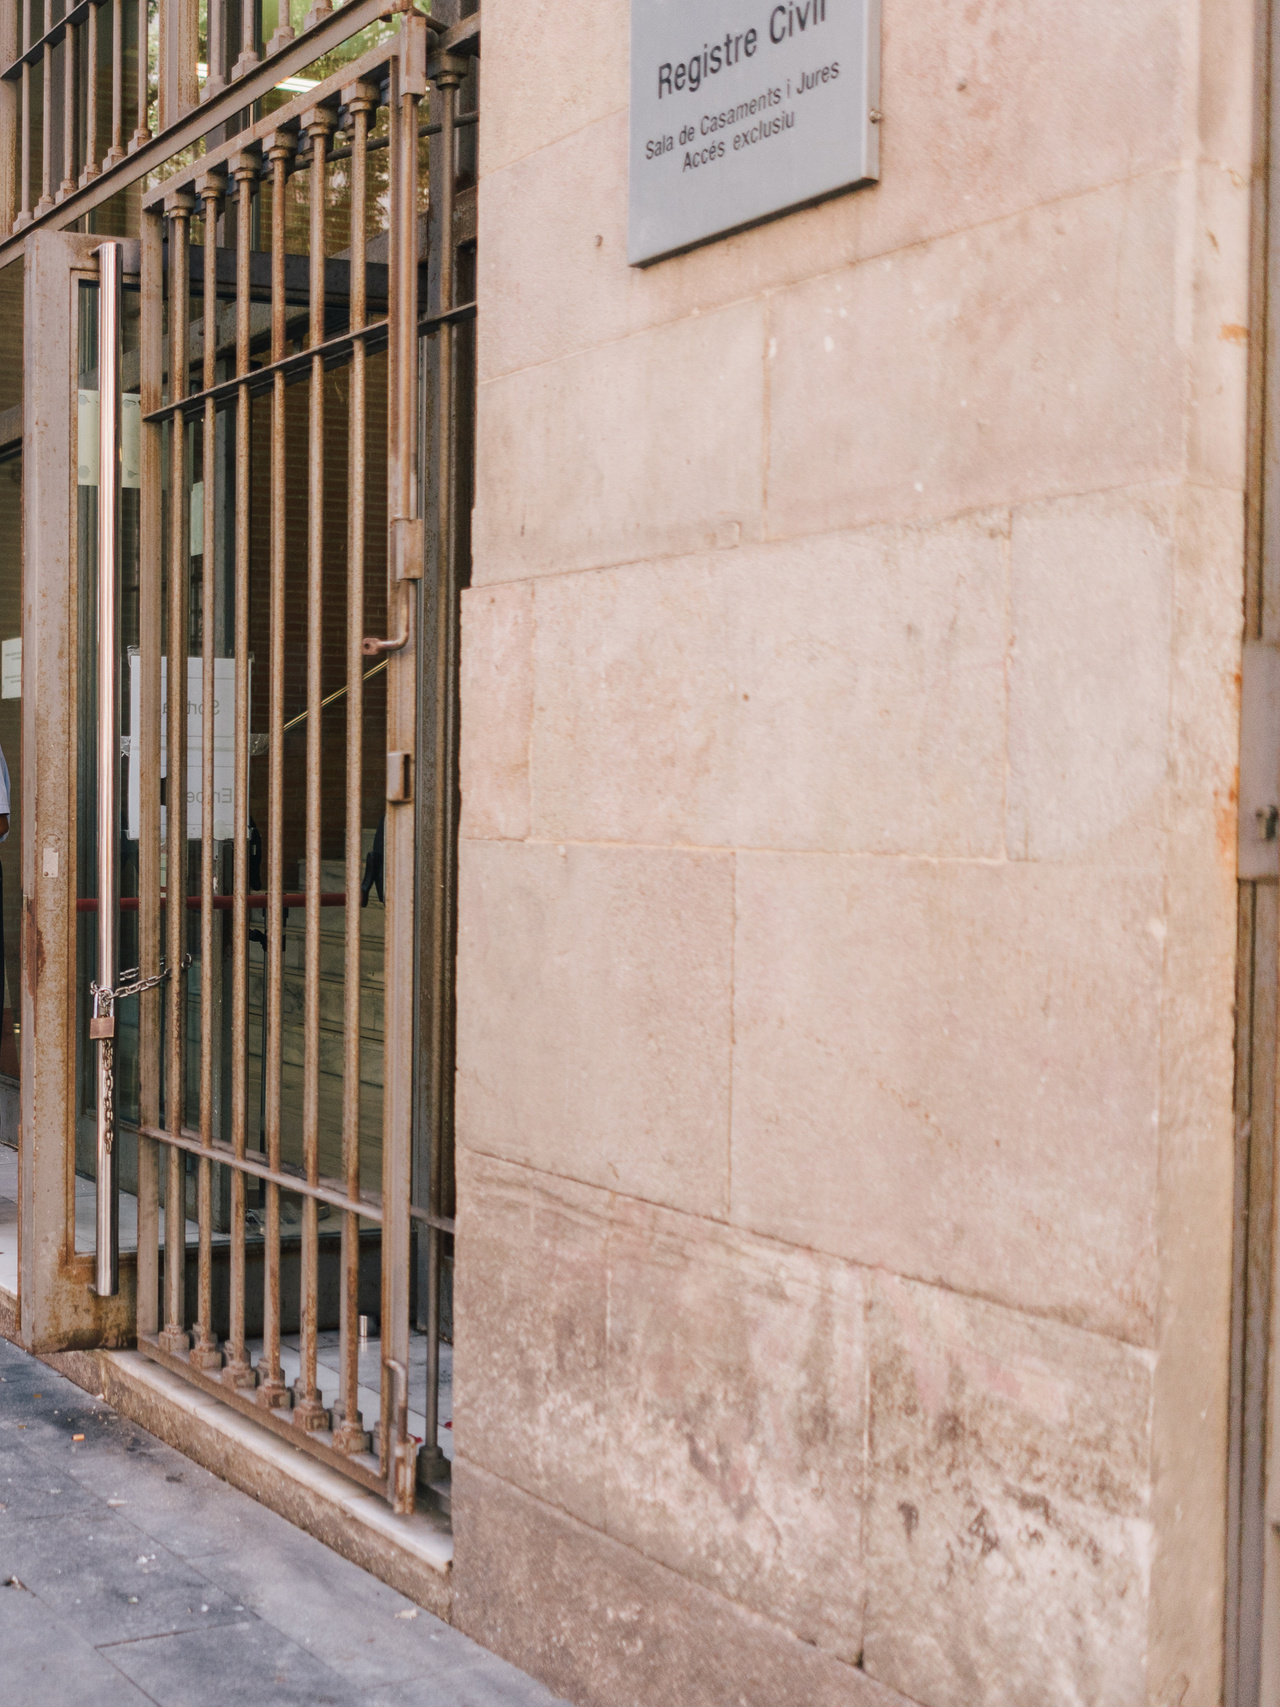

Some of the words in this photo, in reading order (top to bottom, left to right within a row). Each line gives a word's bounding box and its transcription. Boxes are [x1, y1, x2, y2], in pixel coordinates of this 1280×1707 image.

[658, 28, 757, 99] Registre
[770, 0, 826, 44] Civil
[645, 135, 674, 160] Sala
[679, 125, 695, 145] de
[700, 87, 781, 137] Casaments
[786, 79, 791, 99] i
[796, 62, 840, 95] Jures
[682, 140, 725, 172] Accés
[733, 111, 795, 151] exclusiu
